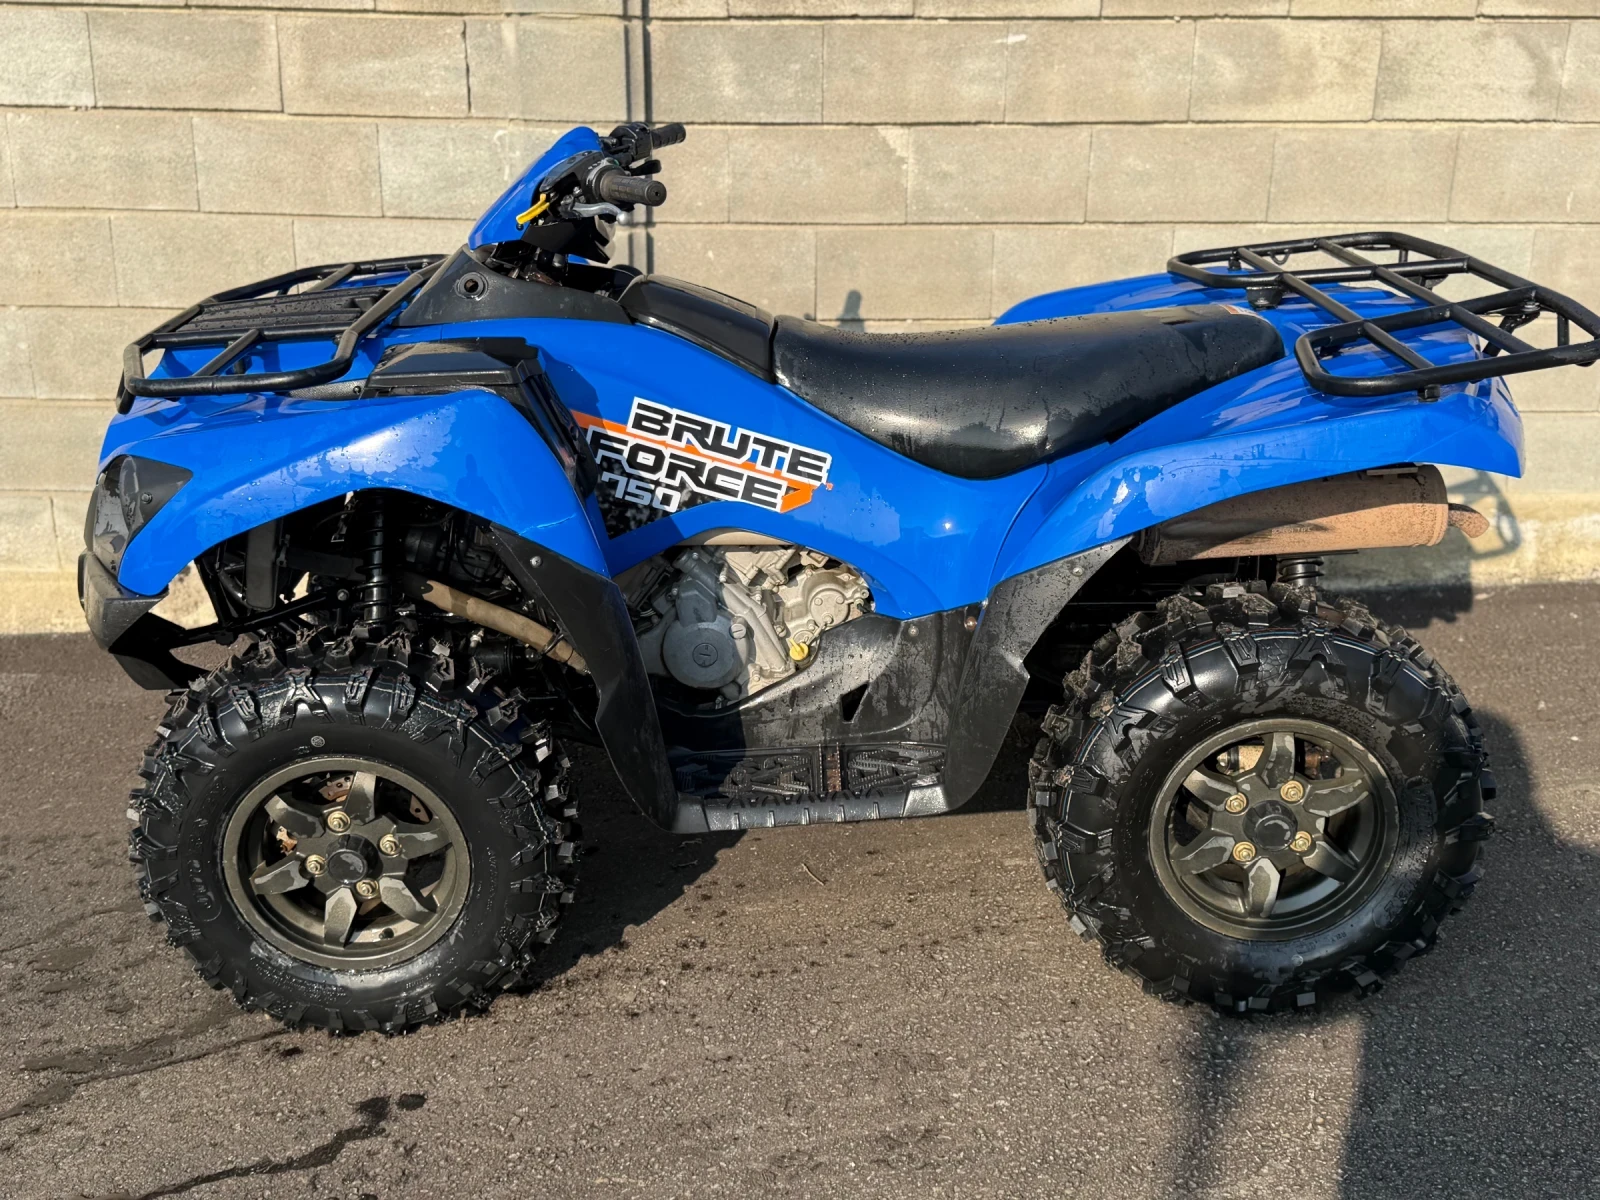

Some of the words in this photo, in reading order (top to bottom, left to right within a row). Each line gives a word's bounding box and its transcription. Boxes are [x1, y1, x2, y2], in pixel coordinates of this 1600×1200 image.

[587, 426, 786, 512] FORCE
[628, 397, 831, 485] BRUTE
[602, 472, 681, 512] 750
